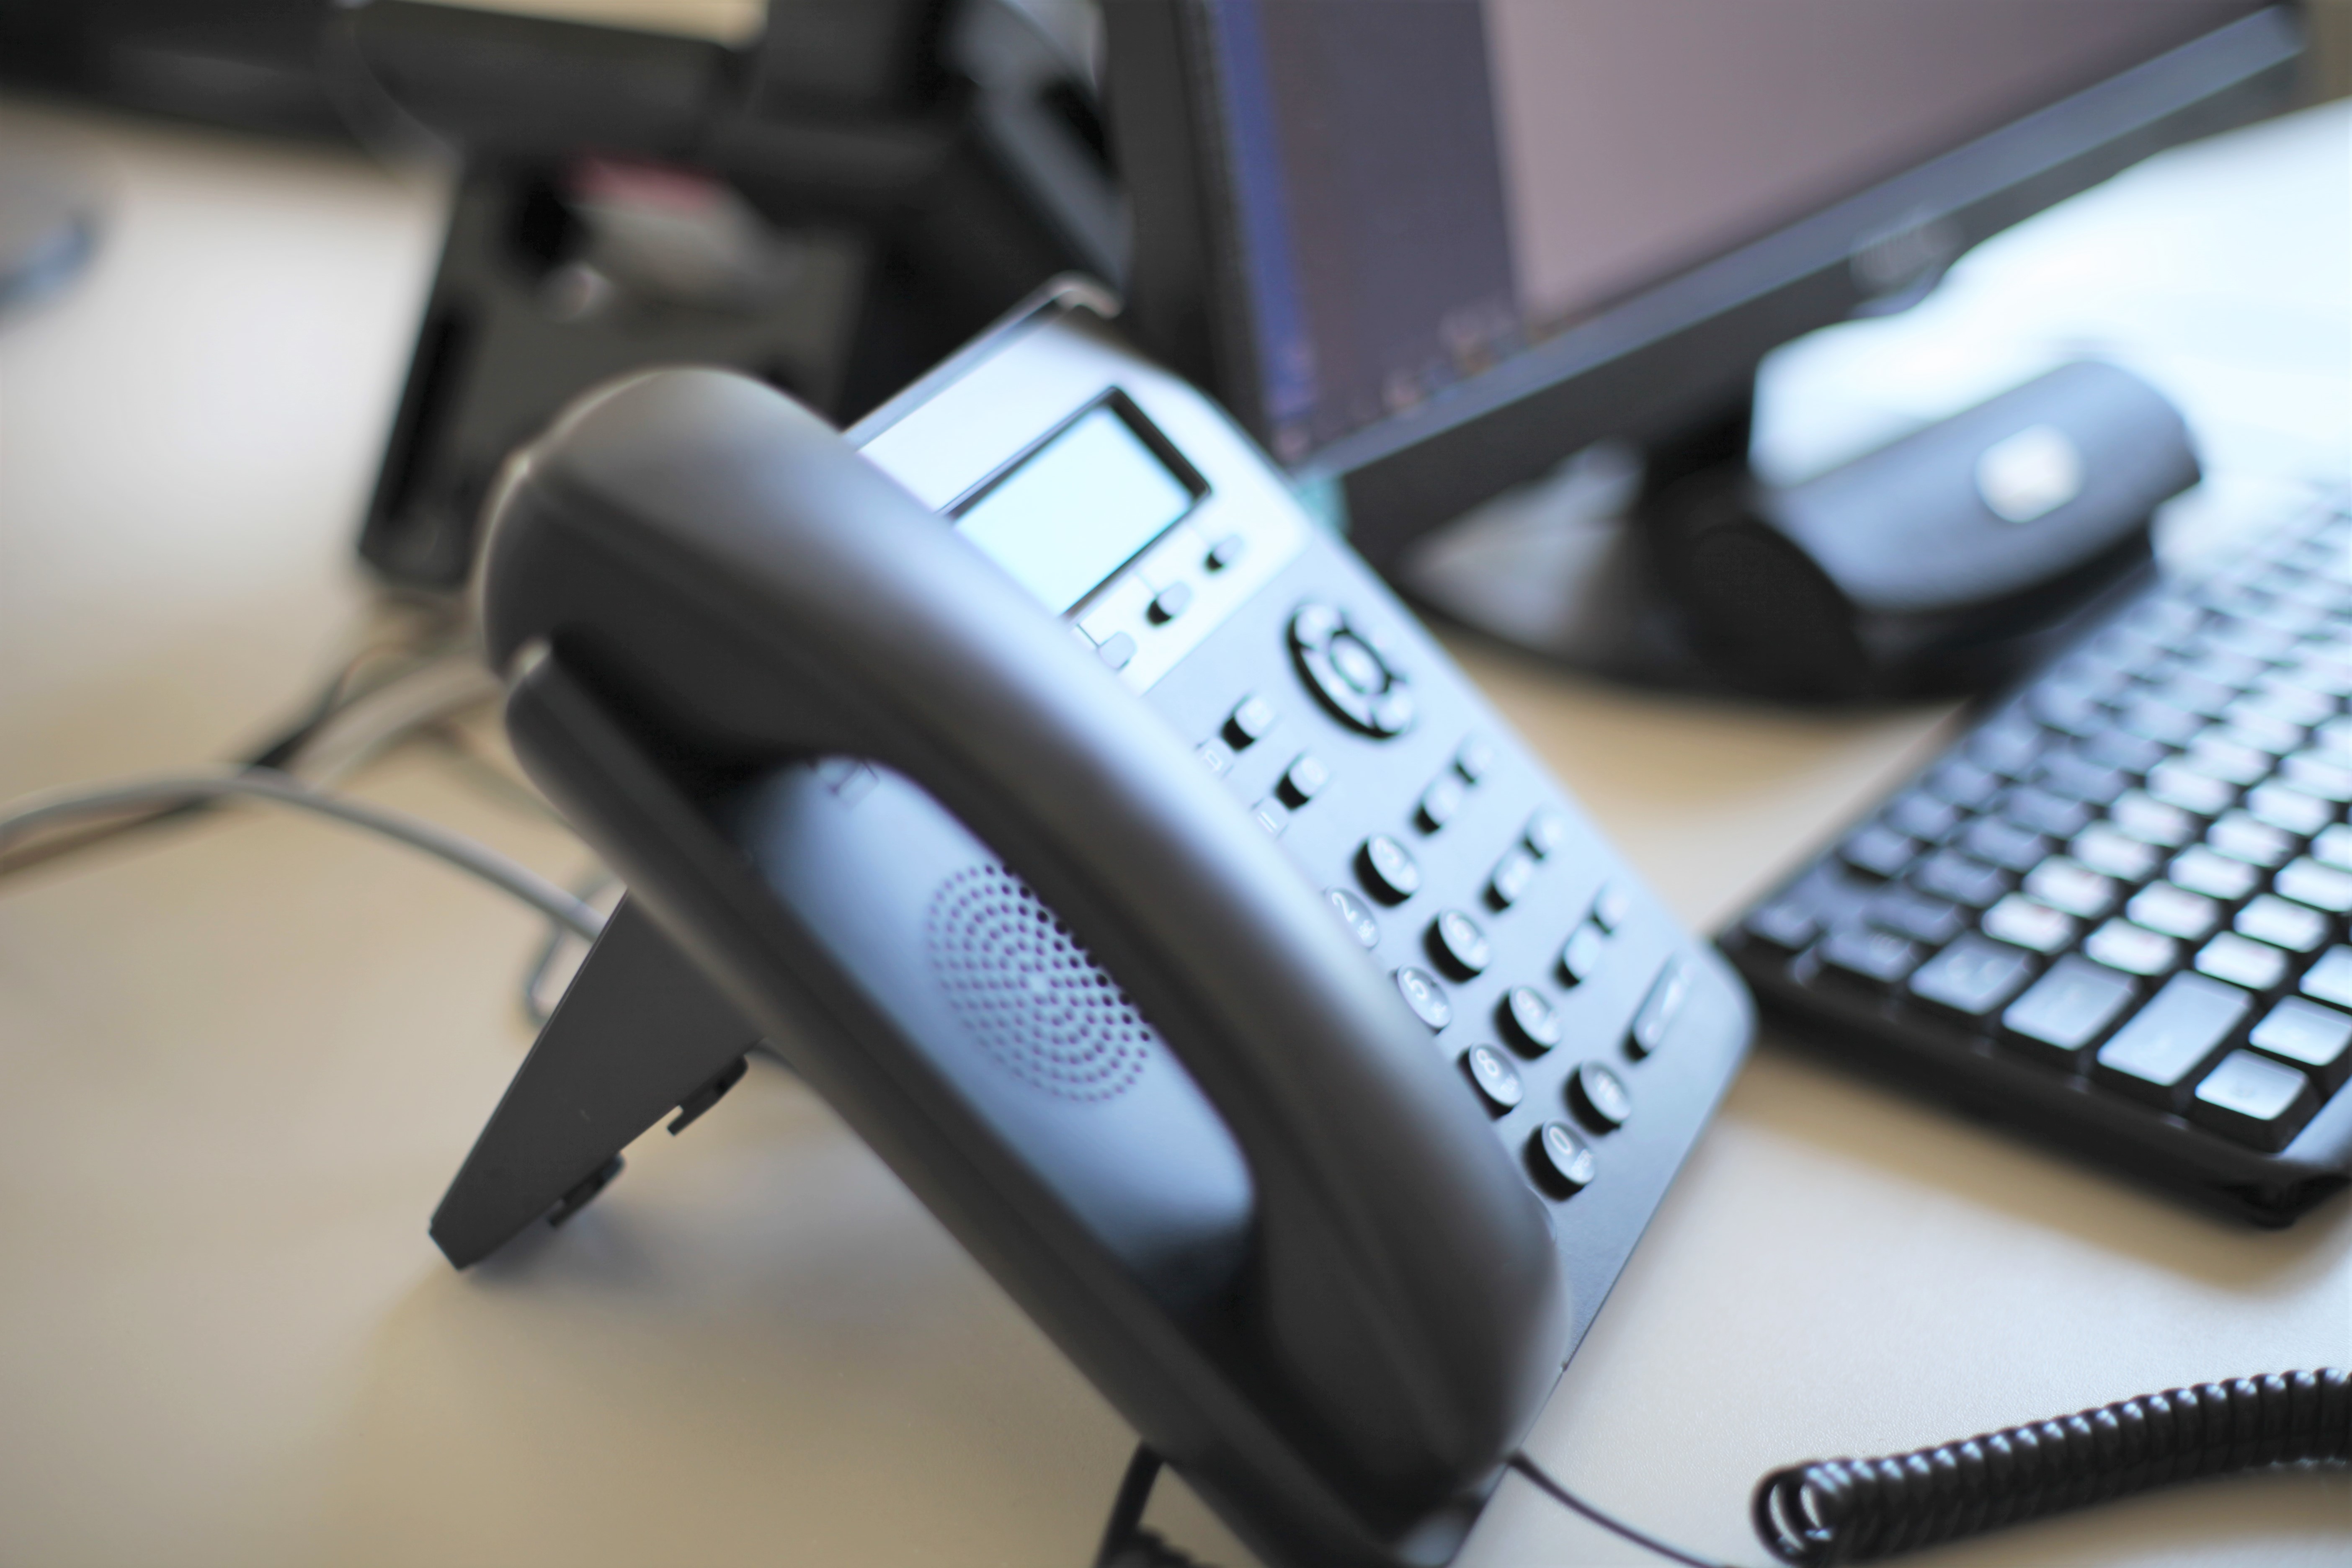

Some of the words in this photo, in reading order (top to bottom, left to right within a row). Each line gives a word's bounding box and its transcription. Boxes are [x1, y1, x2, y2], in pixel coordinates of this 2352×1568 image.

[1331, 892, 1357, 923] 2
[1403, 970, 1428, 999] 5
[1475, 1049, 1500, 1077] 8
[1549, 1126, 1572, 1155] 0
